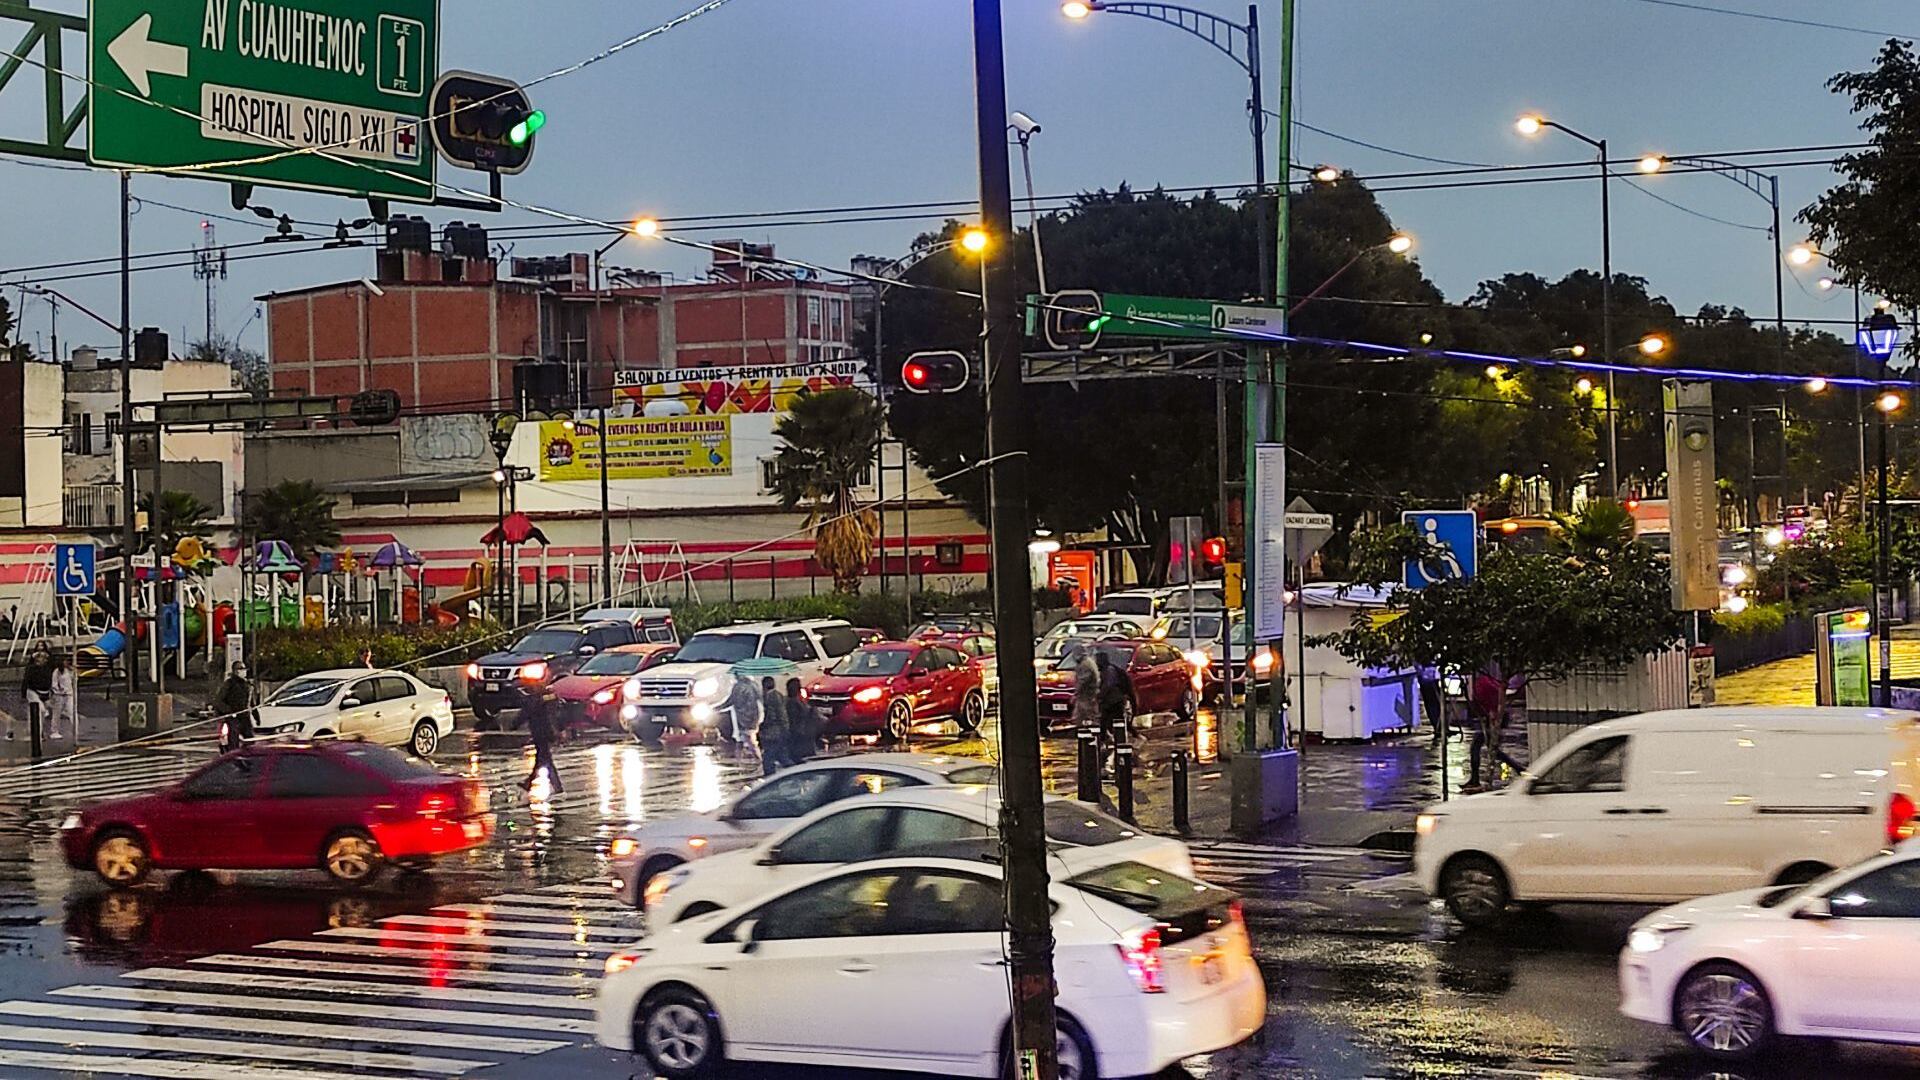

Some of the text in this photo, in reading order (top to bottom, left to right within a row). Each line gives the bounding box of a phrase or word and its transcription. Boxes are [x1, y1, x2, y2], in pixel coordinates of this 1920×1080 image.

[202, 0, 366, 75] AV CUAUHTEMOC
[394, 22, 410, 35] EJE
[397, 36, 405, 77] 1
[394, 79, 408, 90] PTE
[211, 92, 385, 153] HOSPITAL SIGLO XXI
[617, 371, 653, 384] SALON
[657, 371, 671, 382] DE
[676, 369, 722, 381] EVENTOS
[726, 368, 734, 379] Y
[740, 366, 773, 379] RENTA
[776, 366, 788, 378] DE
[819, 364, 827, 375] X
[831, 362, 857, 374] HORA
[608, 424, 639, 435] EVENTOS
[640, 424, 644, 433] Y
[646, 423, 668, 433] RENTA
[670, 422, 678, 433] DE
[705, 421, 725, 431] HORA
[1305, 516, 1331, 525] CARDENAS
